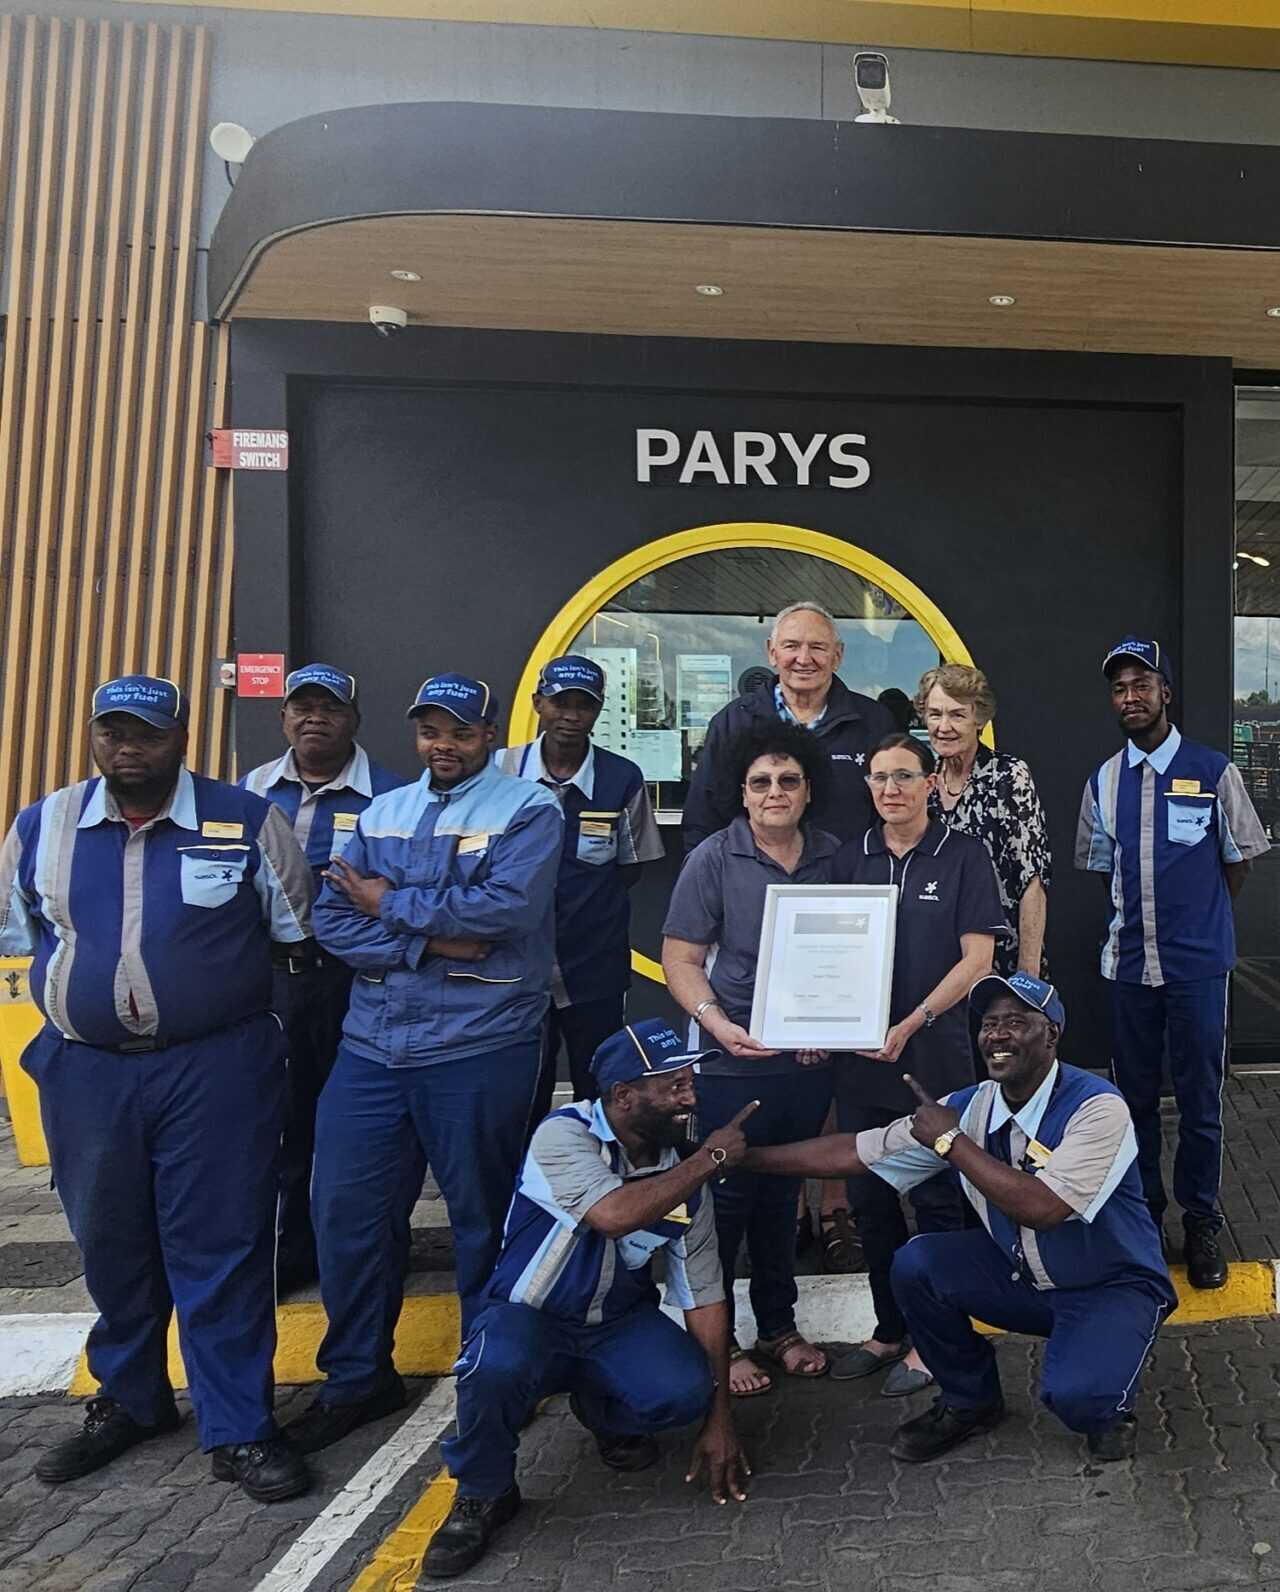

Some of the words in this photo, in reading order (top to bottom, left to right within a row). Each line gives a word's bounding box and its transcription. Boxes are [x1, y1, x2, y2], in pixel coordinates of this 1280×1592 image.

[232, 432, 289, 449] FIREMANS
[239, 451, 281, 468] SWITCH
[636, 428, 871, 489] PARYS
[240, 665, 281, 673] EMERGENCY
[251, 676, 270, 685] STOP
[124, 683, 147, 693] isn't
[147, 687, 169, 698] just
[446, 688, 469, 699] fuel
[110, 692, 131, 702] any
[133, 692, 159, 703] fuel
